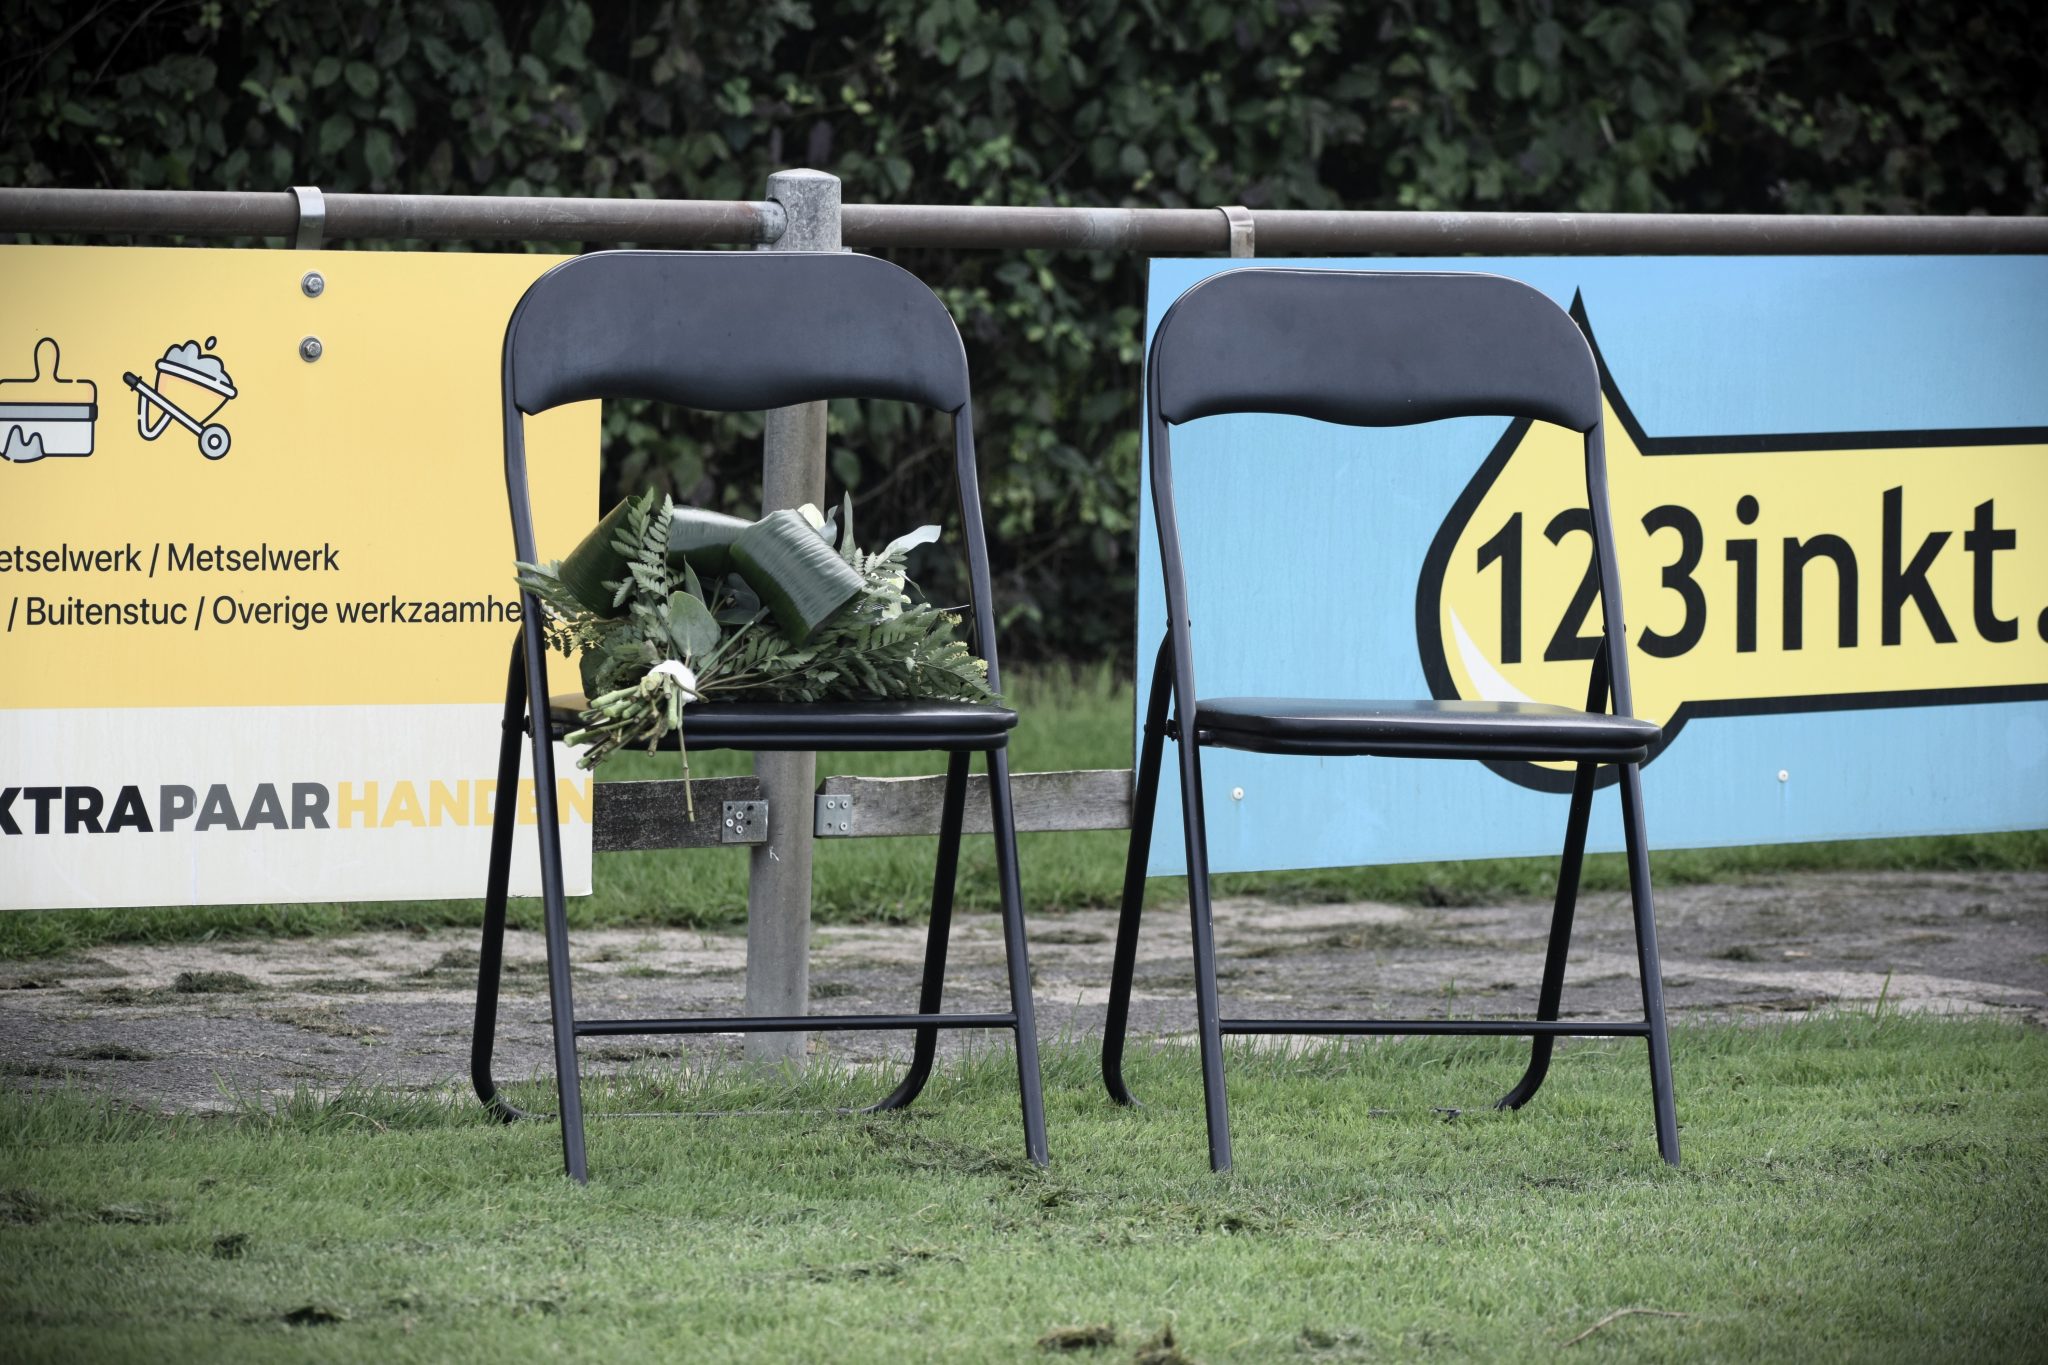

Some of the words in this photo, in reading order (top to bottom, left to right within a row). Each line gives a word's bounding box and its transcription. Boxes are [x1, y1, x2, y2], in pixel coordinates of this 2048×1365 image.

[0, 543, 142, 572] etselwerk
[167, 542, 340, 572] Metselwerk
[26, 596, 187, 625] Buitenstuc
[213, 595, 328, 630] Overige
[336, 594, 521, 623] werkzaamhe
